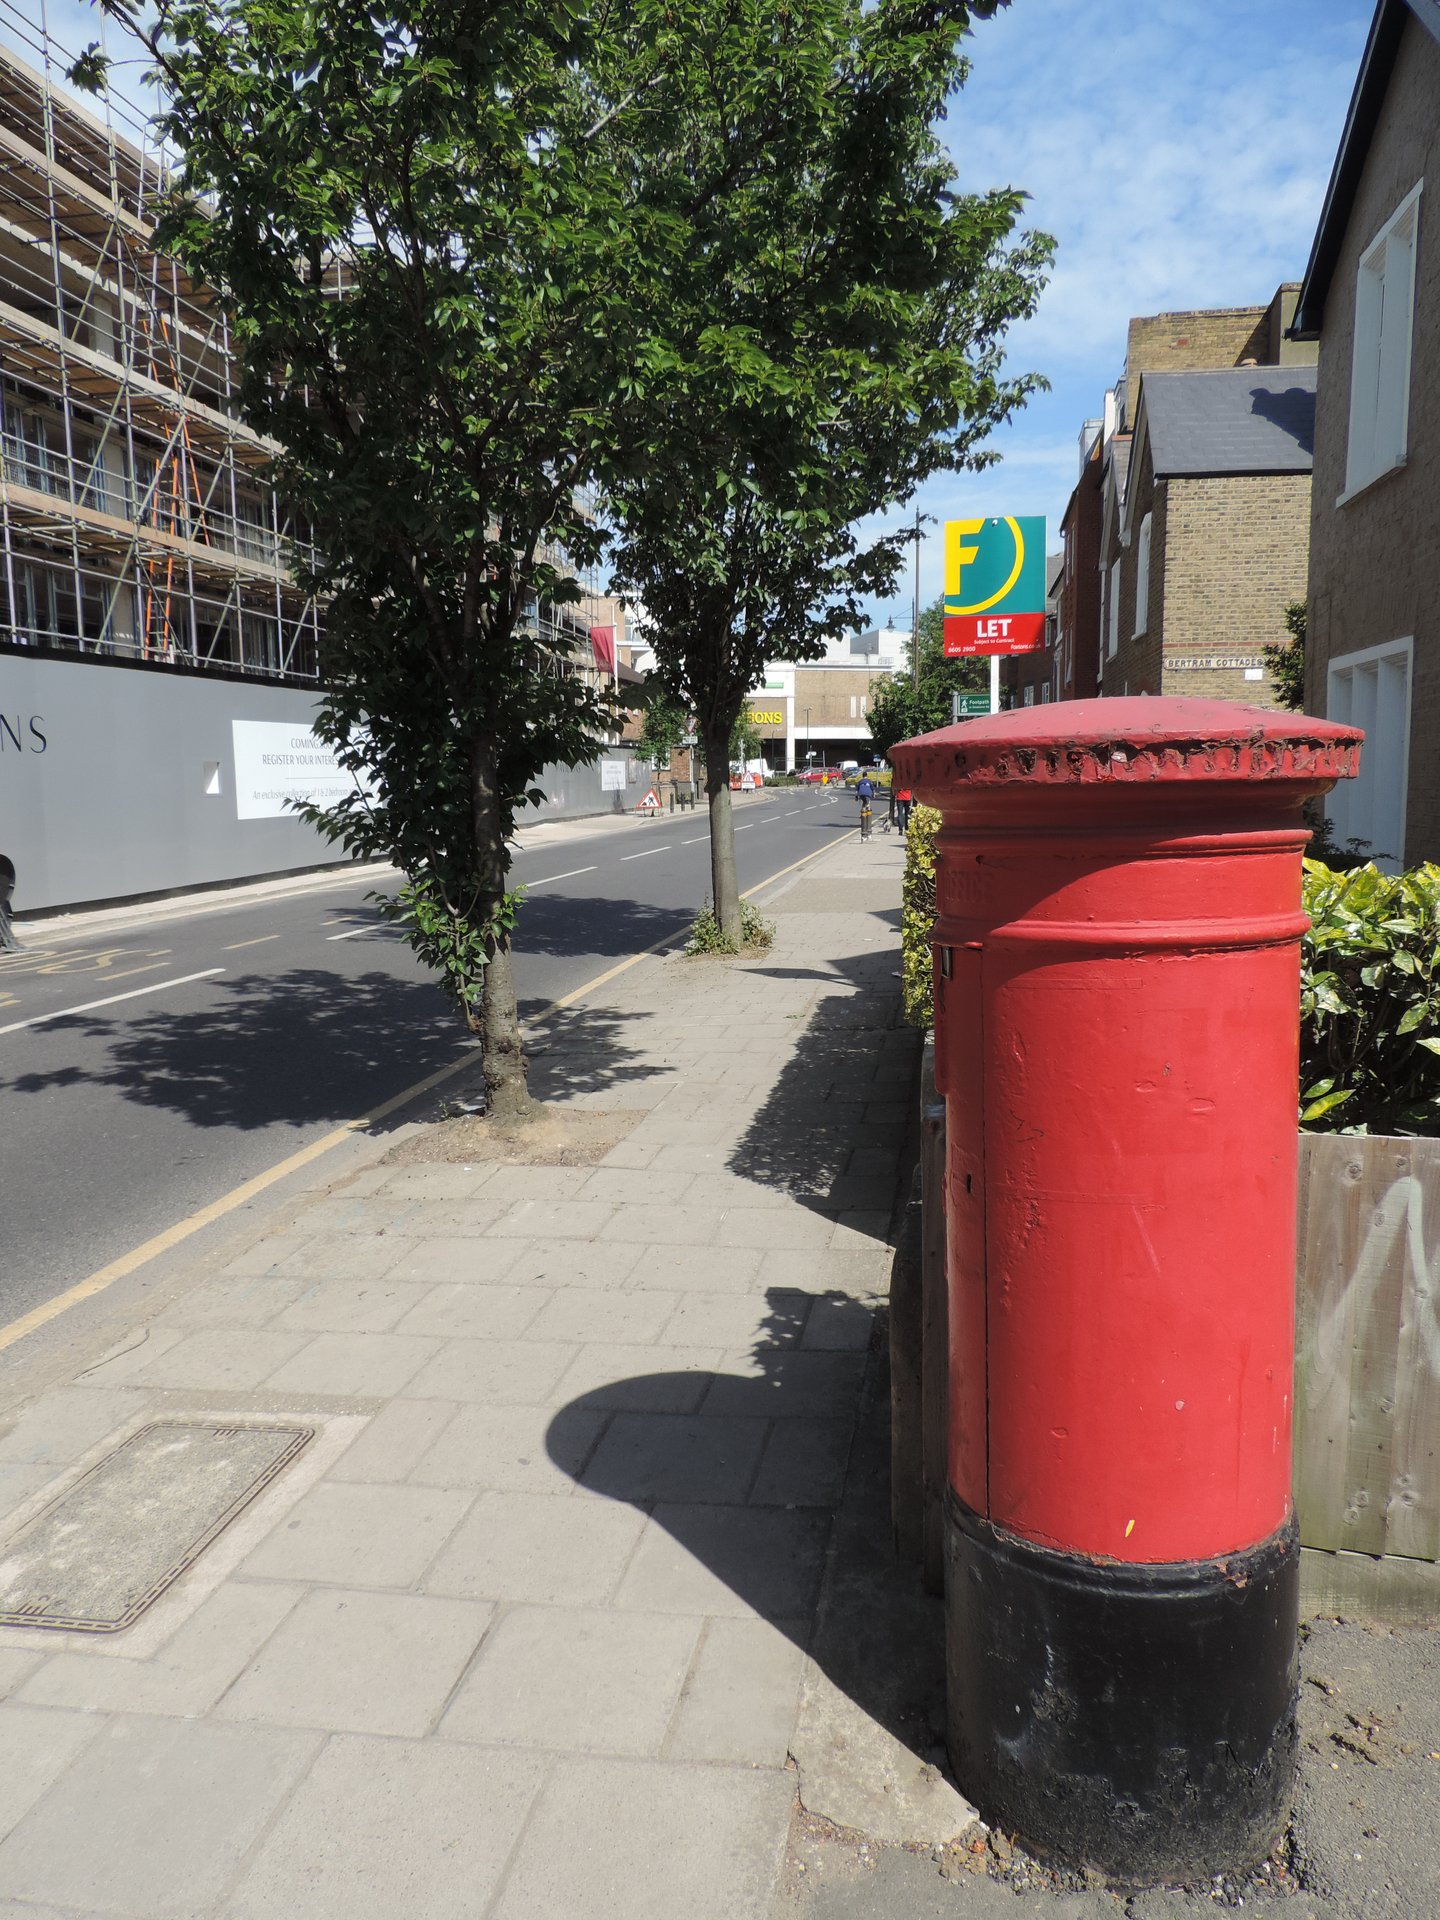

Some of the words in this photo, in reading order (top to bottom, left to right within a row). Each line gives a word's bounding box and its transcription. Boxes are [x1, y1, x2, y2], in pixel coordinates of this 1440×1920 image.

[976, 618, 1013, 638] LET
[1168, 659, 1212, 668] BERTRAM
[1216, 658, 1264, 667] COTTAGES
[0, 713, 47, 754] NS
[290, 738, 319, 749] COMING
[262, 754, 295, 765] REGISTER
[295, 755, 314, 765] YOUR
[314, 755, 340, 765] INTERES
[252, 790, 261, 800] An
[261, 789, 285, 800] exclusive
